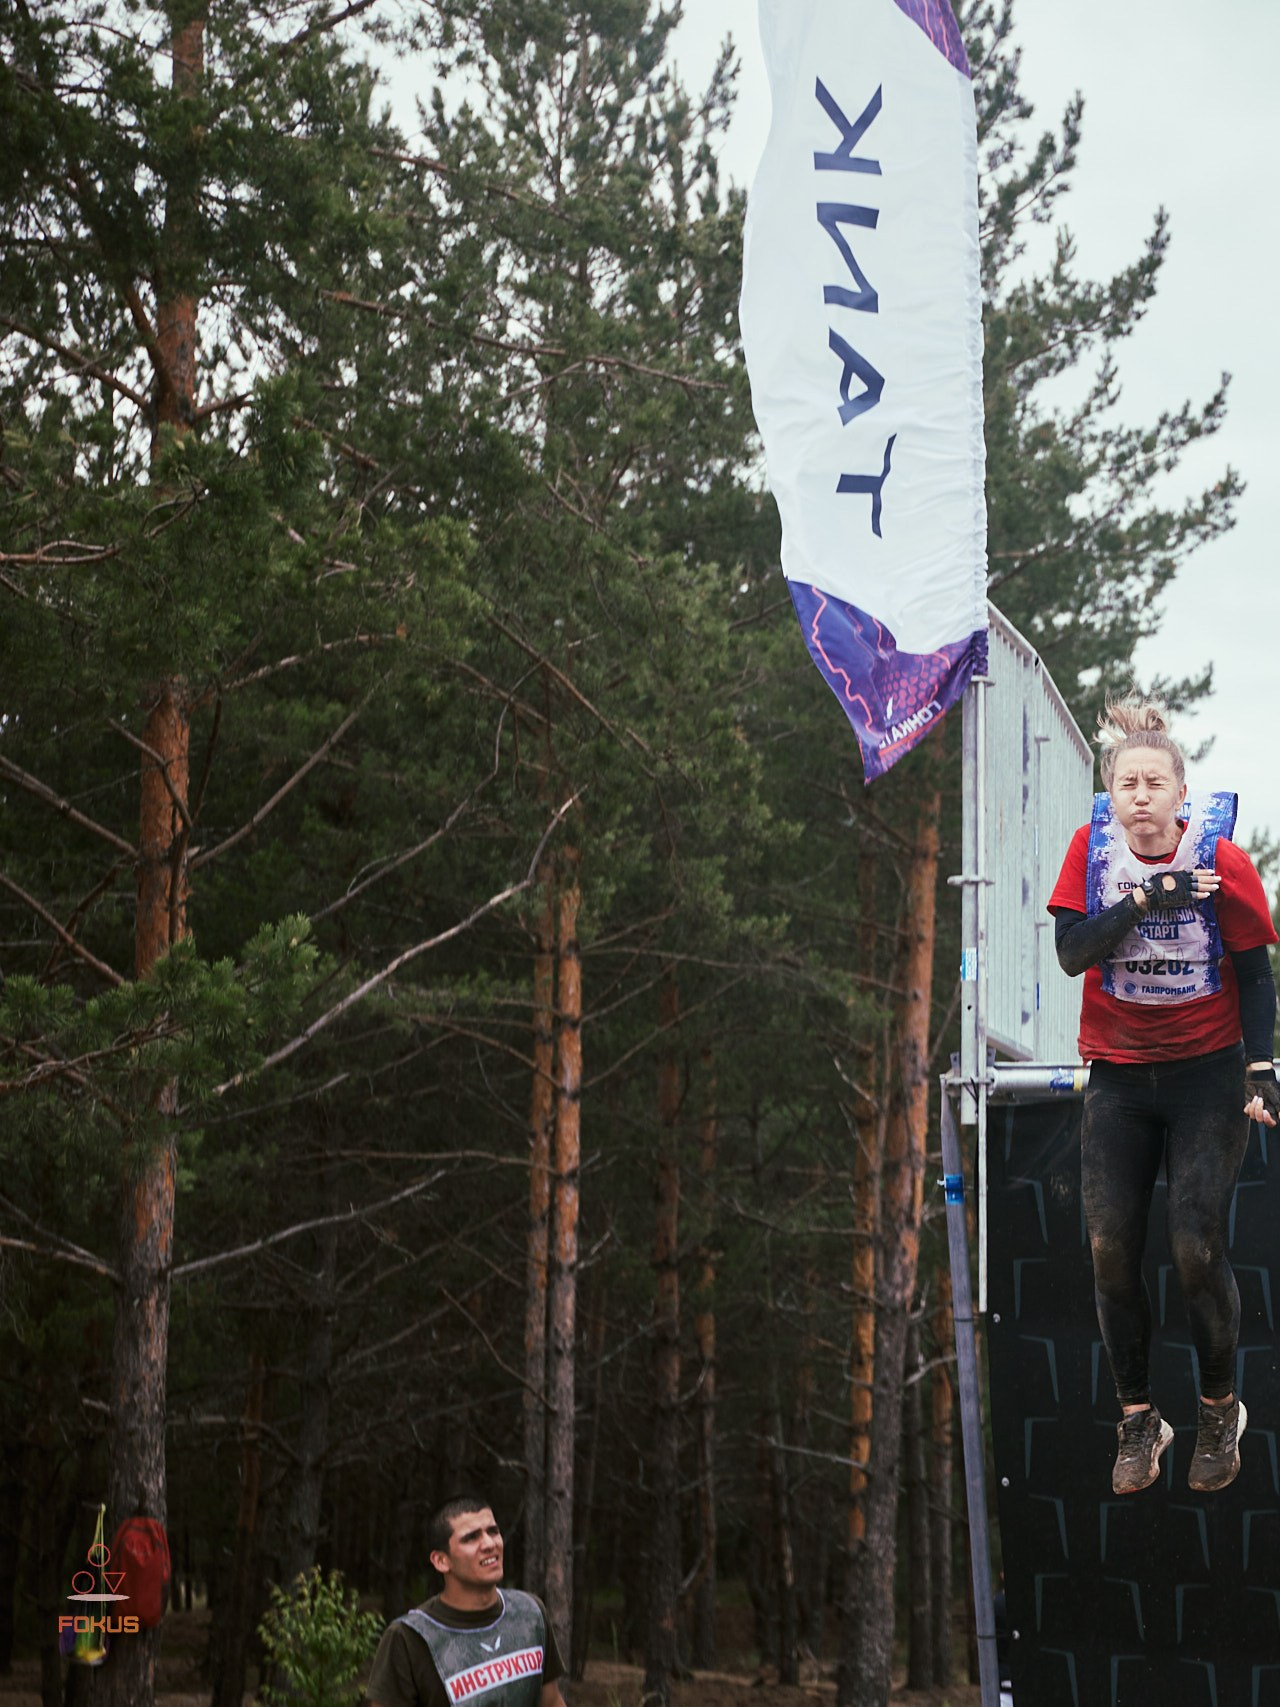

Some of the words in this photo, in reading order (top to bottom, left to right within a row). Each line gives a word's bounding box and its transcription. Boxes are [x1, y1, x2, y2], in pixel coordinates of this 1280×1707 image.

[1117, 881, 1138, 890] ГОН
[1141, 907, 1195, 925] АНДНЫЙ
[1141, 924, 1177, 939] СТАРТ
[1141, 985, 1196, 995] ГАЗПРОМБАНК
[450, 1650, 543, 1700] ИНСТРУКТОР
